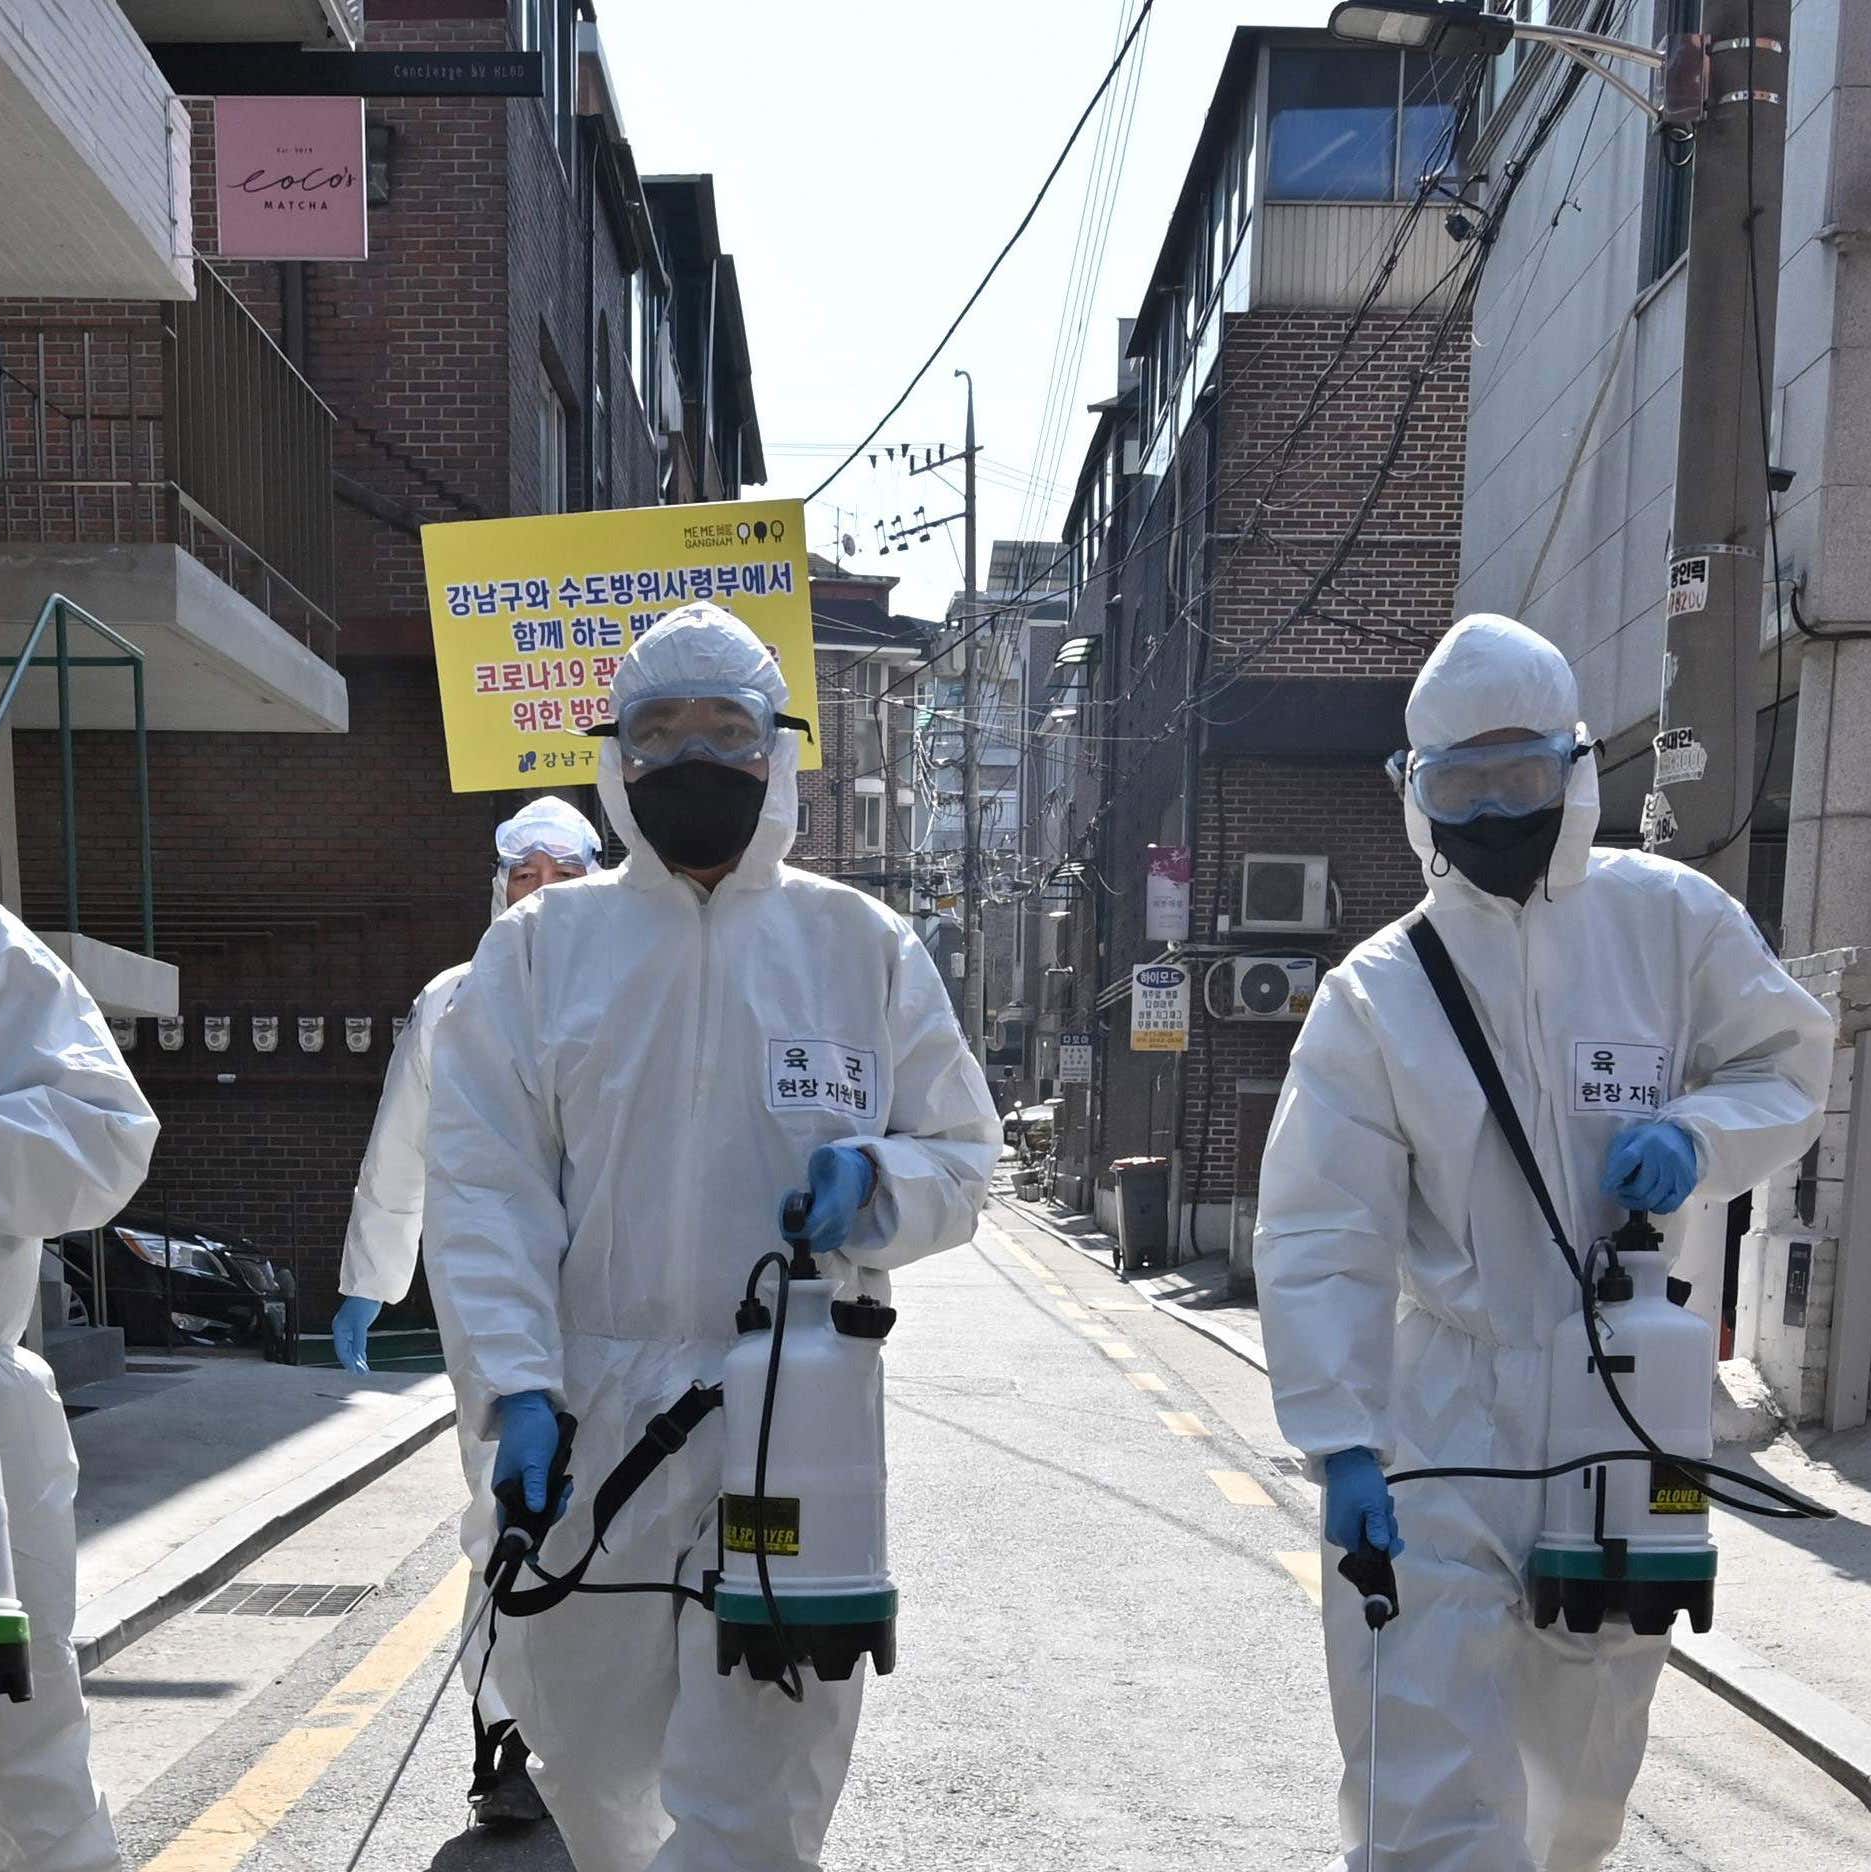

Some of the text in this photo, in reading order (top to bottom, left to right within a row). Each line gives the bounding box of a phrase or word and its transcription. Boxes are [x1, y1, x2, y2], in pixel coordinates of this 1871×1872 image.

[264, 201, 328, 210] MATCHA
[685, 537, 733, 549] GANGNAM
[447, 562, 793, 616] 강남구와 수도방위사령부에서
[512, 619, 563, 652] 함께
[572, 615, 622, 646] 하는
[476, 659, 585, 694] 코로나19
[513, 700, 562, 731] 위한
[543, 750, 597, 769] 강남구
[1140, 971, 1181, 985] 하이모드
[784, 1048, 863, 1082] 육 군
[1590, 1050, 1615, 1075] 육
[777, 1079, 867, 1110] 현장 지원팀
[1581, 1082, 1623, 1103] 현장
[739, 1527, 795, 1544] SPYER
